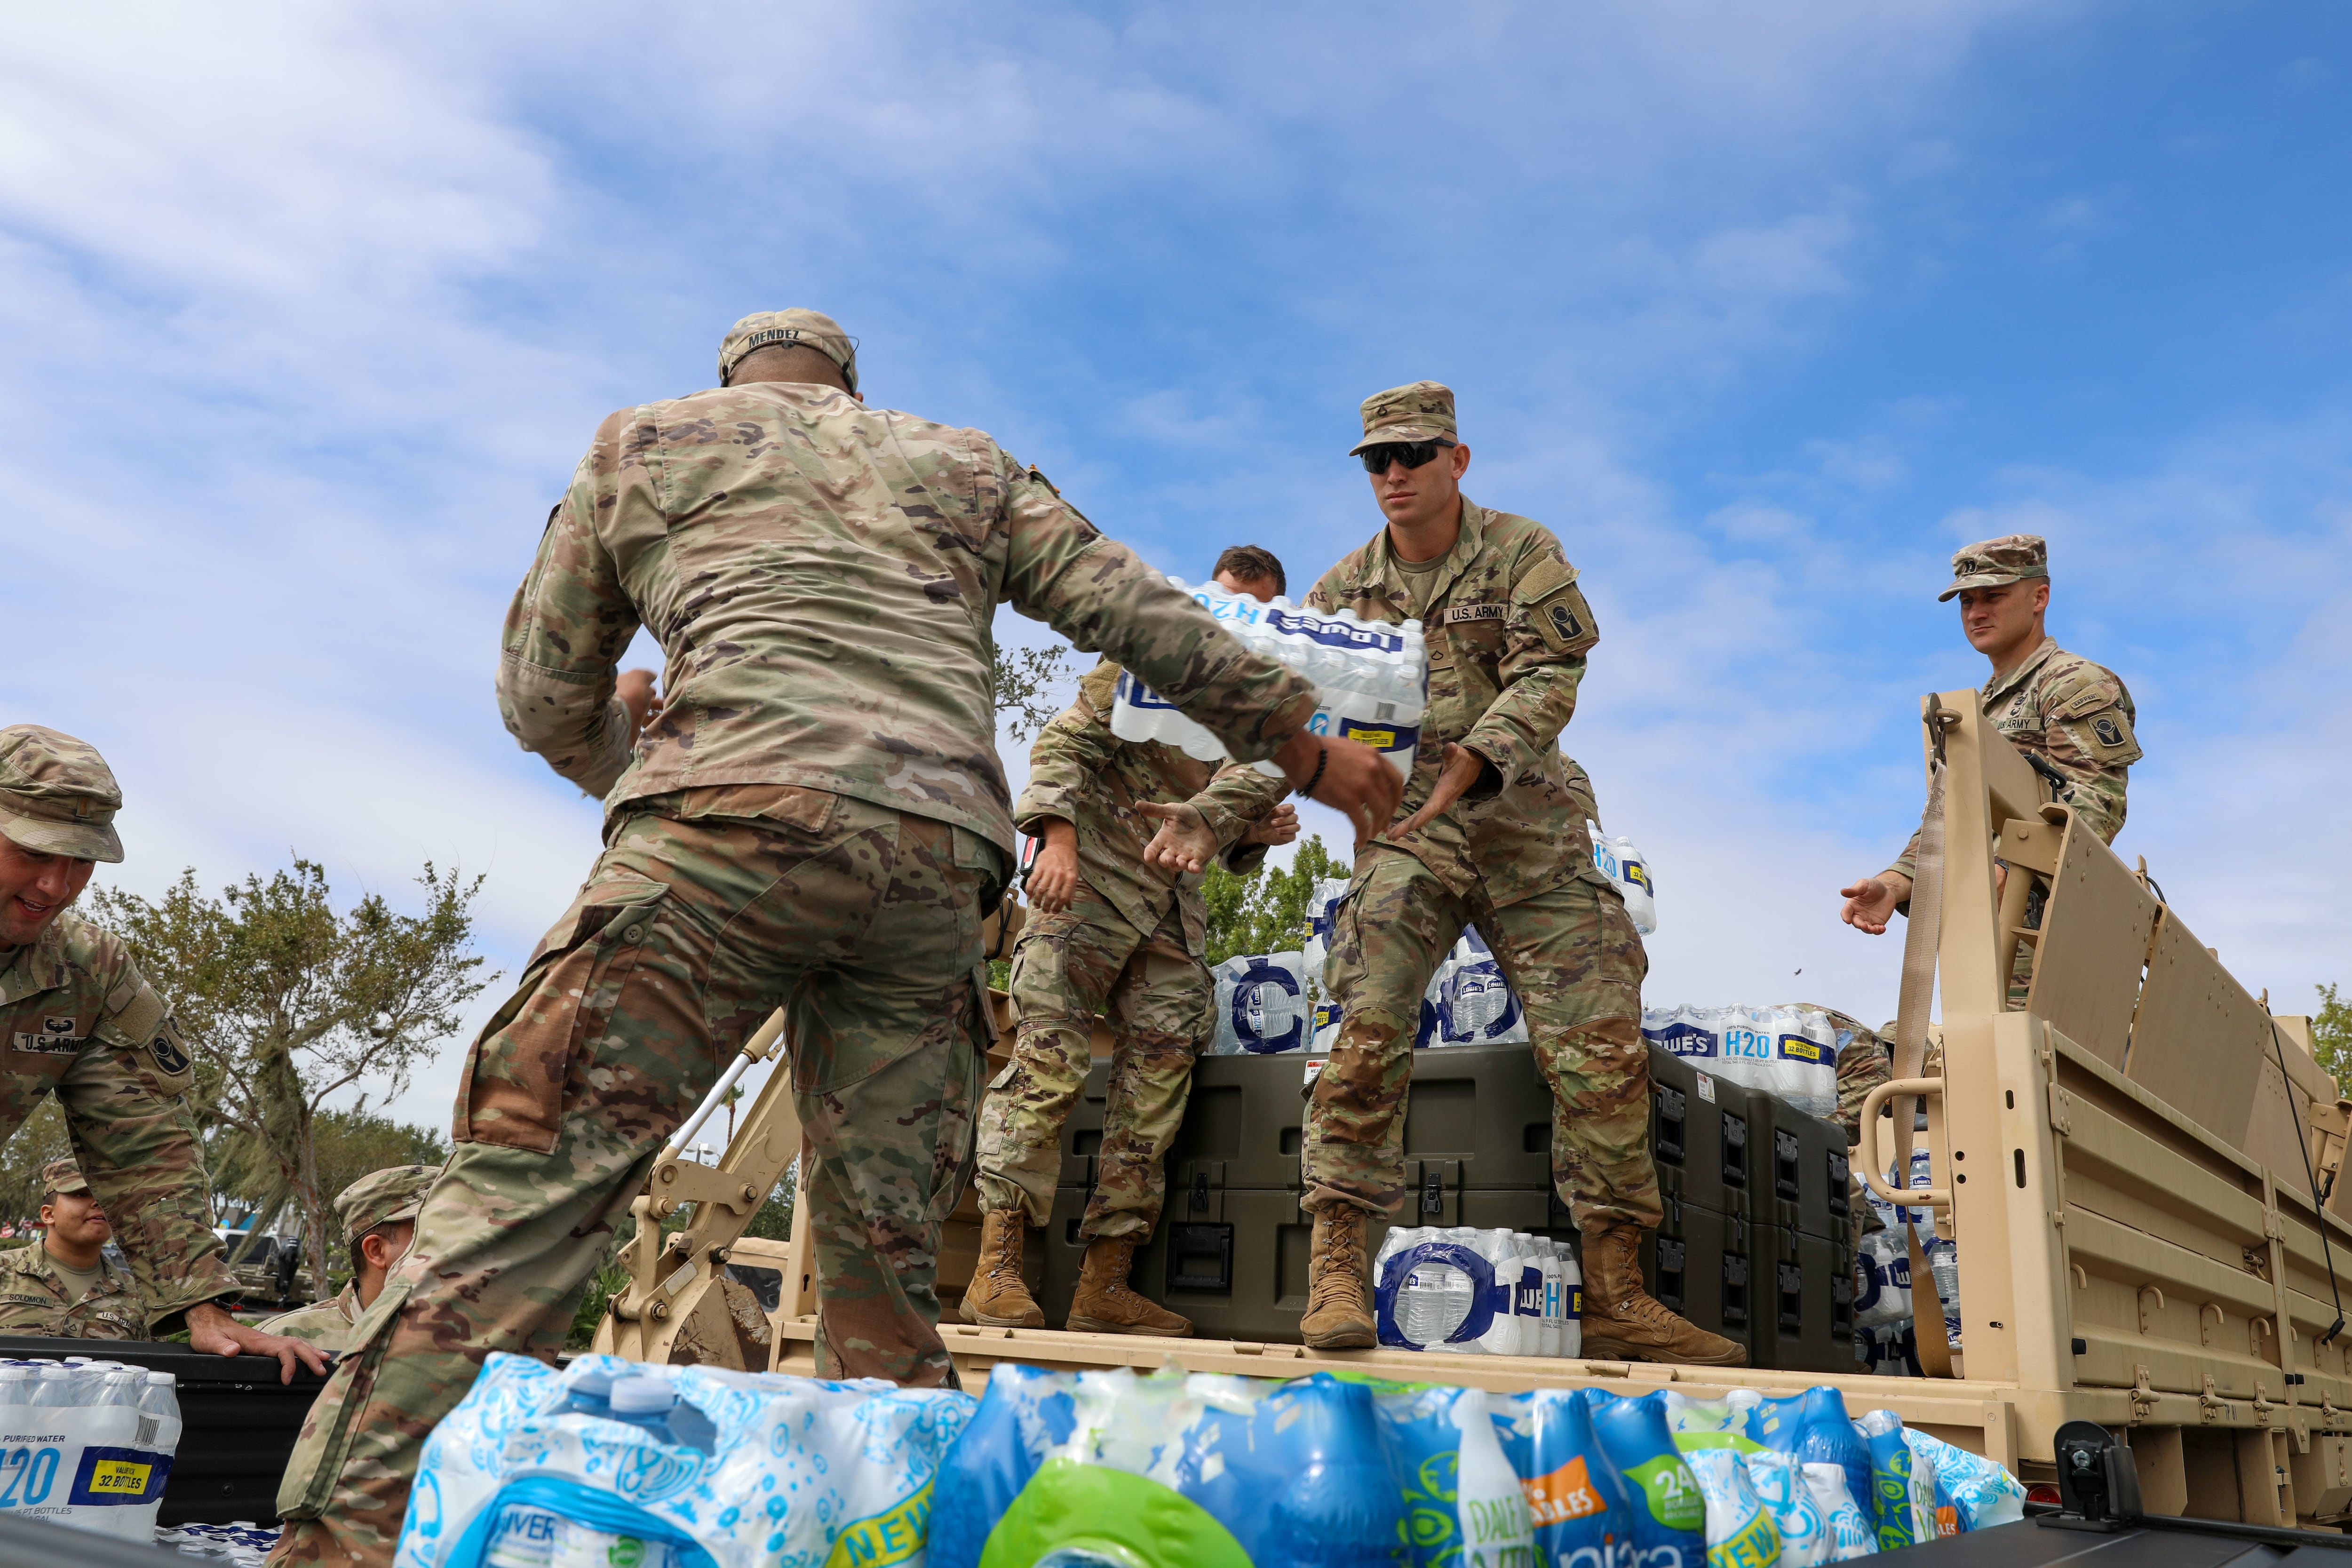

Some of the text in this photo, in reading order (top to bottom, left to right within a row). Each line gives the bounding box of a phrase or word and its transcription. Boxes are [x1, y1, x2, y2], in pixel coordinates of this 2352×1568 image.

[749, 329, 800, 349] MENDEZ
[1452, 606, 1503, 621] U.S. ARMY
[2074, 694, 2097, 707] SAPPER
[2006, 719, 2030, 729] ARMY
[1463, 985, 1482, 993] LOWE'S
[52, 1038, 83, 1053] ARM
[1796, 1047, 1816, 1057] BOTTLES
[9, 1294, 46, 1305] SOLOMON
[102, 1312, 136, 1331] U.S. ARMY
[98, 1475, 142, 1489] 32 BOTTLES
[1655, 1464, 1697, 1500] 24
